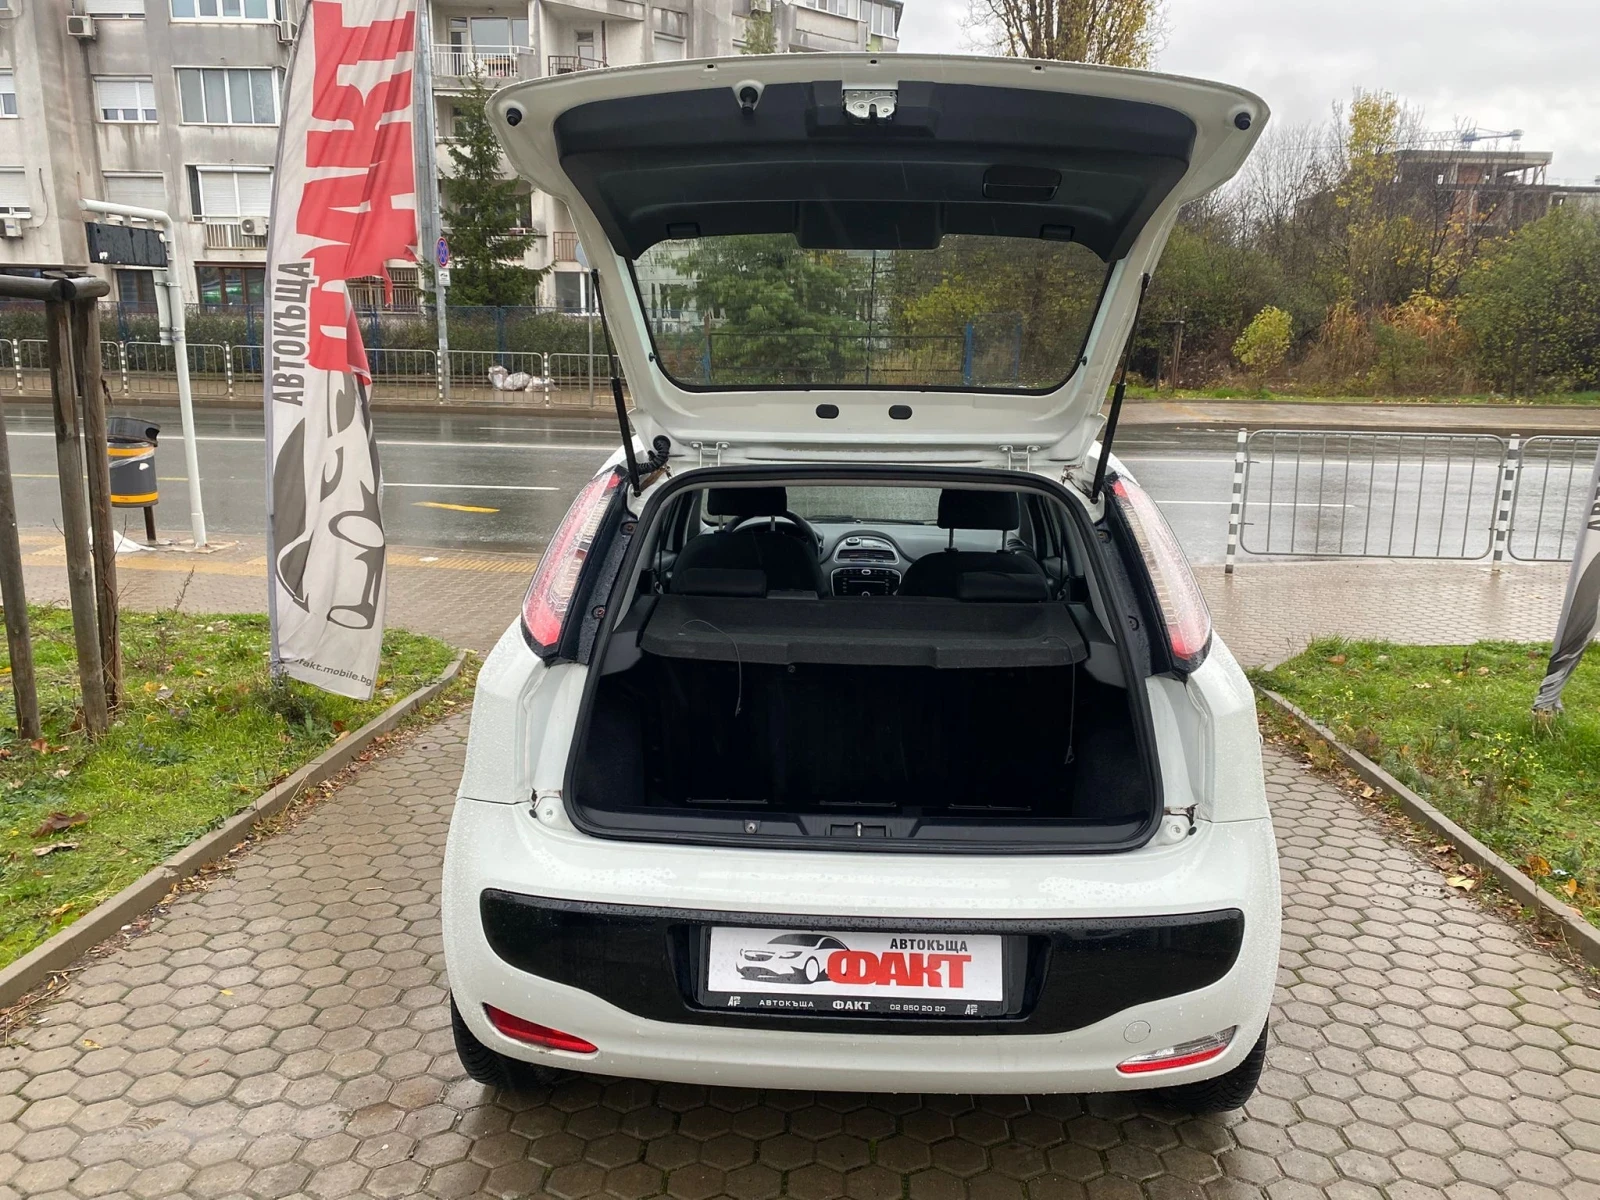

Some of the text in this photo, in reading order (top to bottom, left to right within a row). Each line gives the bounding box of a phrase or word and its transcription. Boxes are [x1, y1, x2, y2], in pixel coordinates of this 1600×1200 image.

[272, 261, 316, 407] АВТОКЪЩА
[890, 938, 968, 953] АВТОКЪЩА
[827, 950, 972, 988] ФАКТ
[832, 1000, 871, 1011] ФАКТ
